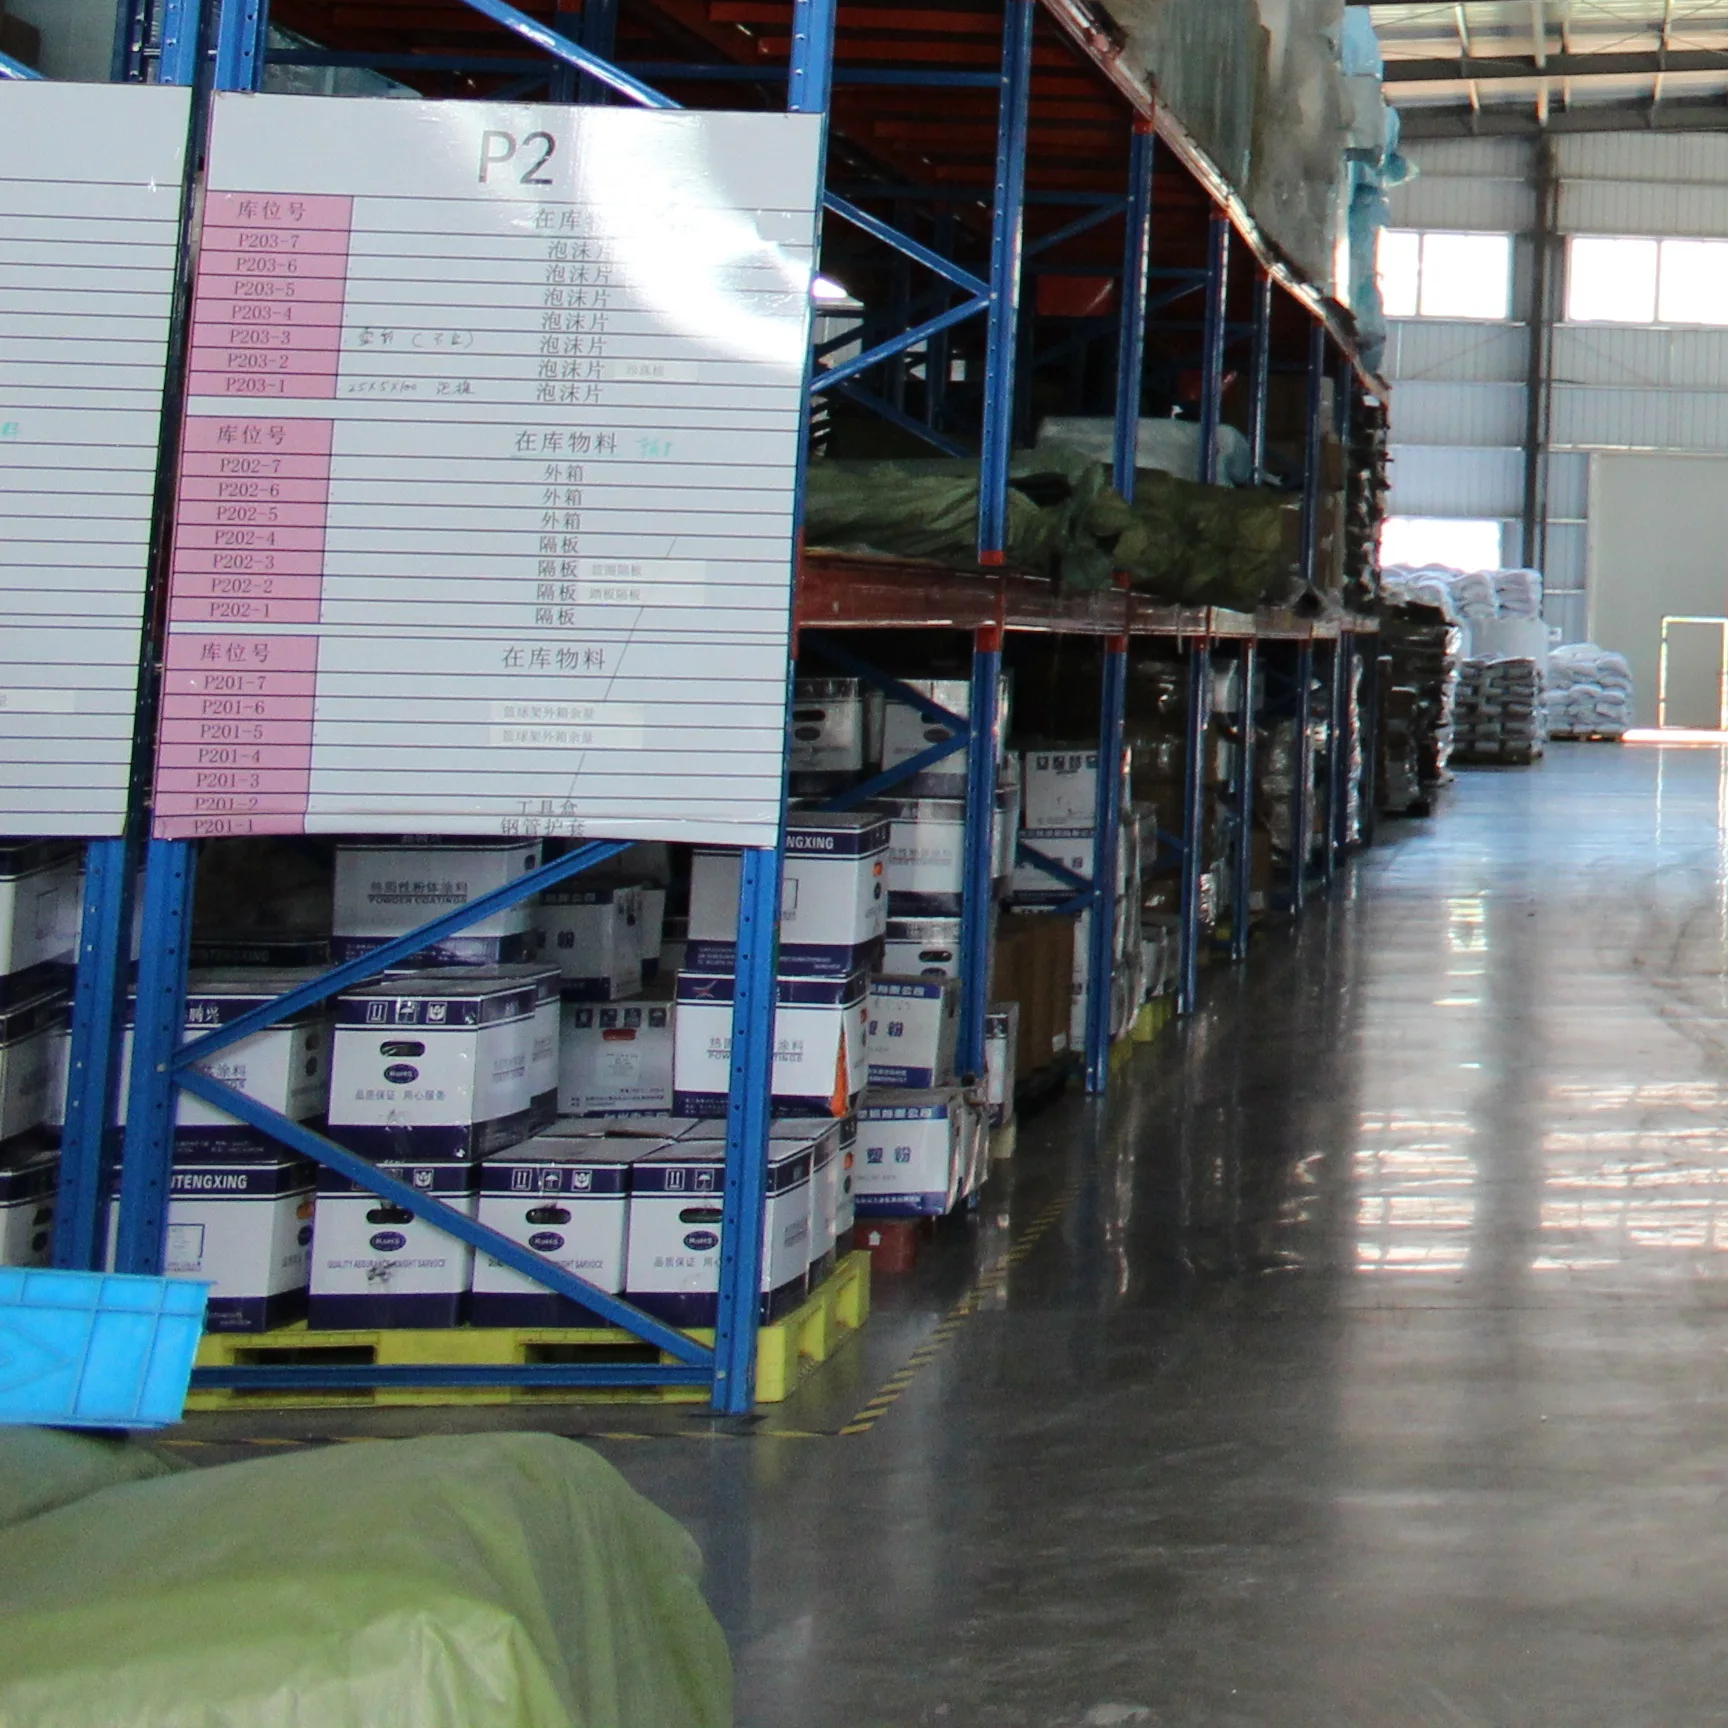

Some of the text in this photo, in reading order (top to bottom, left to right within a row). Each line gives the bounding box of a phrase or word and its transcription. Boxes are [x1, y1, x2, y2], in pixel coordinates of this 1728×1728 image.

[479, 131, 556, 185] P2
[237, 200, 305, 221] 库位号
[239, 233, 299, 248] P203-7
[236, 257, 297, 272] P203-6
[546, 264, 612, 284] 泡沫片
[234, 281, 295, 296] P203-5
[544, 289, 610, 308] 泡沫片
[232, 305, 291, 321] P203-4
[542, 313, 608, 330] 泡沫片
[230, 329, 290, 344] P203-3
[543, 336, 606, 353] 泡沫片
[228, 353, 289, 369] P203-2
[538, 361, 604, 379] 泡沫片
[226, 377, 284, 393] P203-1
[537, 383, 604, 403] 泡沫片
[218, 425, 285, 445] 库位号
[515, 430, 616, 454] 在库物料
[220, 458, 281, 473] P202-7
[544, 465, 583, 482] 外箱
[219, 482, 279, 497] P202-6
[543, 488, 583, 506] 外箱
[217, 506, 278, 521] P202-5
[542, 512, 580, 530] 外箱
[215, 530, 275, 545] P202-4
[540, 536, 578, 554] 隔板
[213, 554, 274, 569] P202-3
[539, 560, 577, 577] 隔板
[212, 578, 273, 593] P202-2
[537, 584, 575, 601] 隔板
[210, 602, 269, 618] P202-1
[536, 608, 574, 625] 隔板
[201, 642, 269, 663] 库位号
[503, 646, 605, 670] 在库物料
[204, 675, 266, 690] P201-7
[203, 699, 265, 715] P201-6
[201, 724, 263, 739] P201-5
[199, 748, 260, 763] P201-4
[196, 773, 259, 788] P201-3
[195, 797, 259, 810] P201-2
[193, 818, 255, 834] P201-1
[785, 837, 834, 850] NGXING
